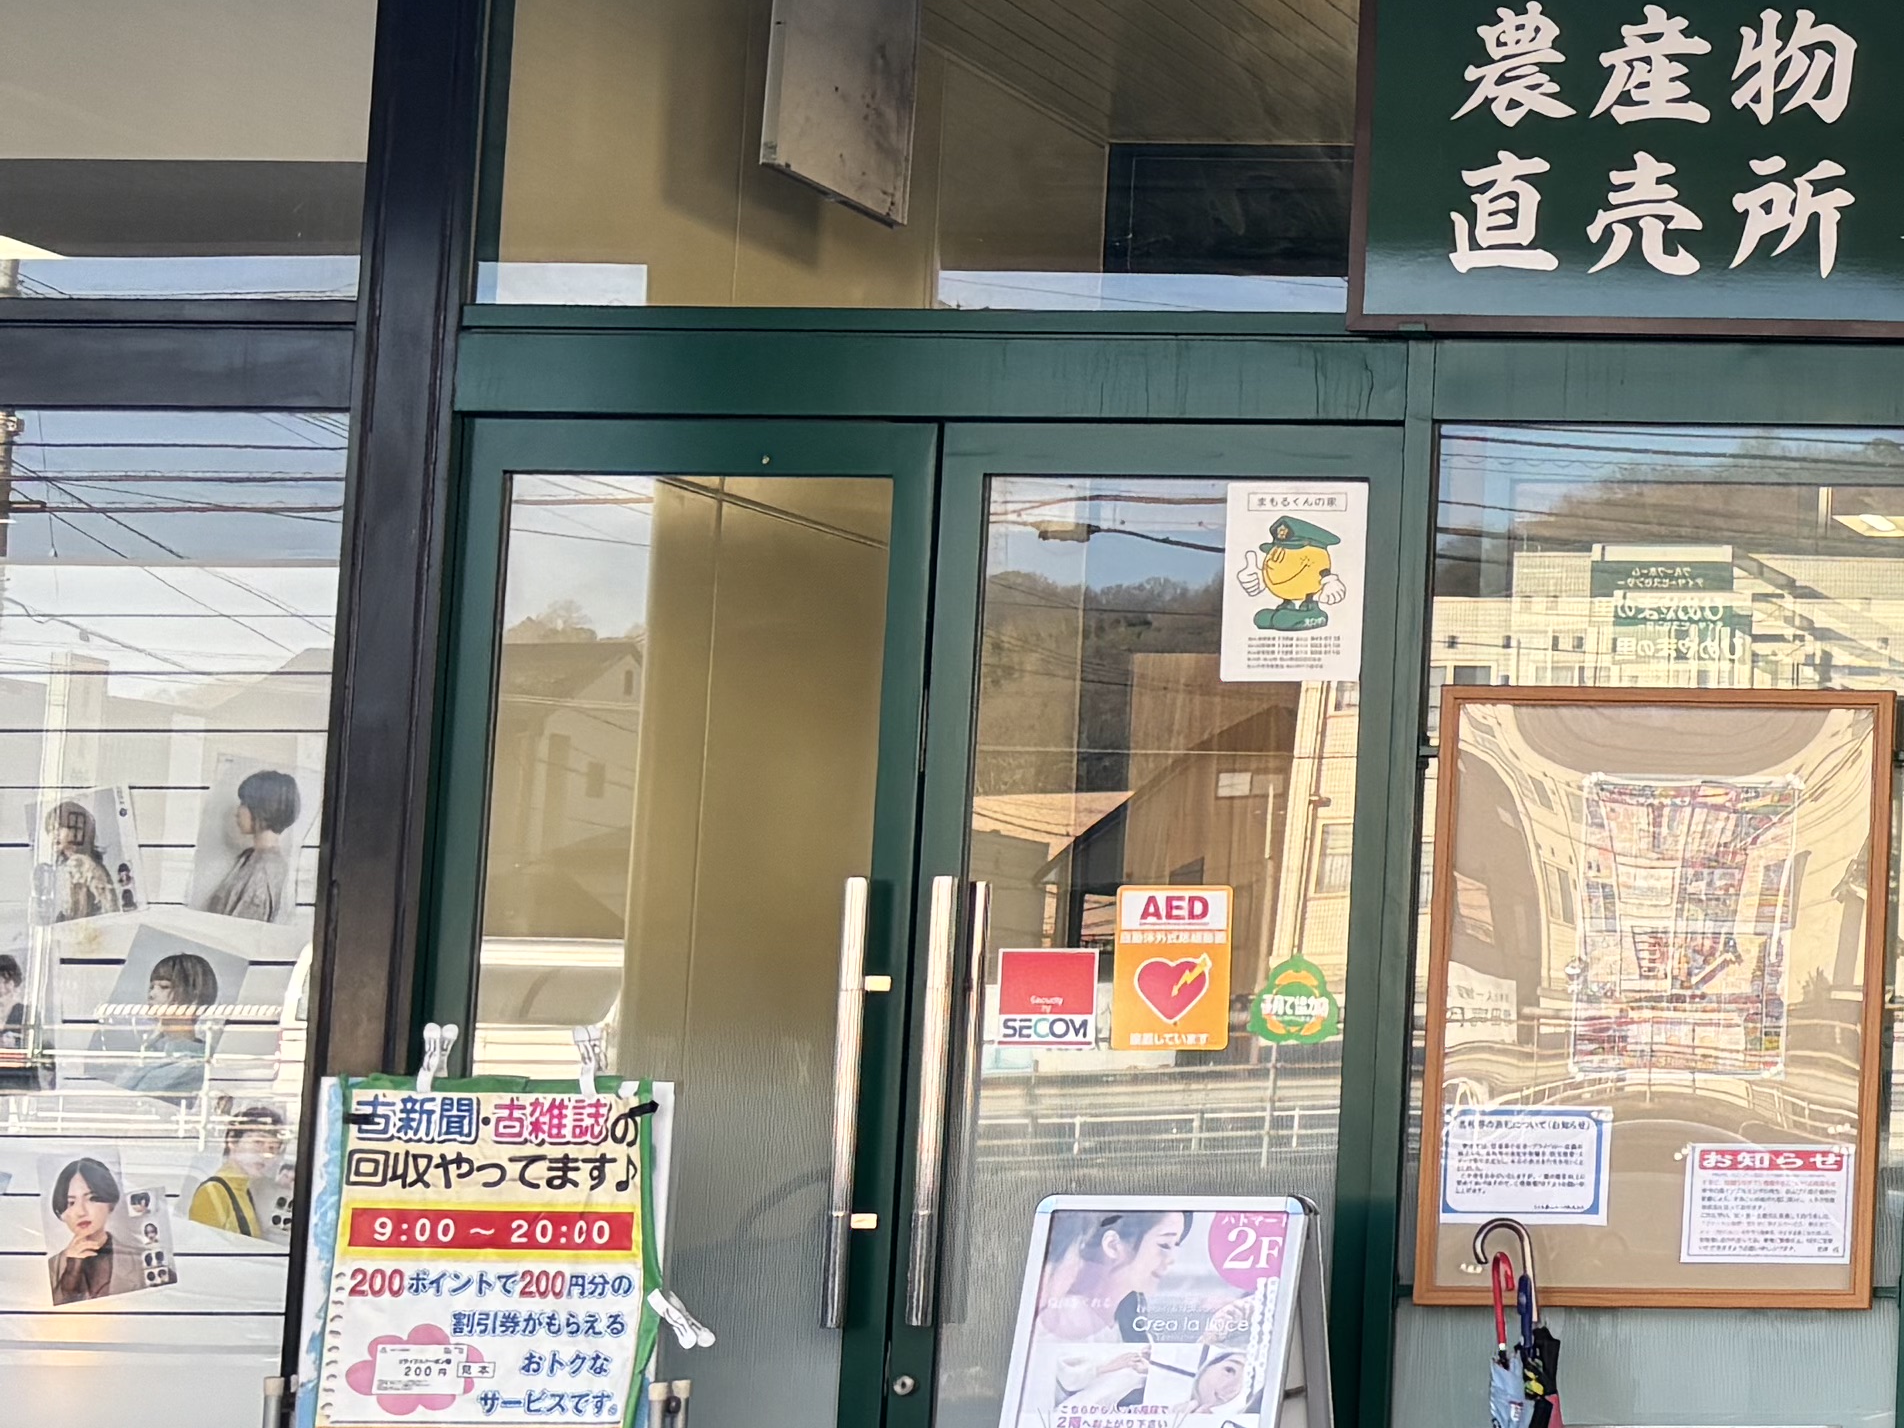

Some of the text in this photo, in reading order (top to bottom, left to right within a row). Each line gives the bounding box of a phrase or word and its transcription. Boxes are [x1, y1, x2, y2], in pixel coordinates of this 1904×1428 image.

[1449, 1, 1858, 128] 農産物
[1448, 150, 1857, 280] 直売所
[1140, 895, 1210, 921] AED
[1002, 1017, 1088, 1040] SECOM
[354, 1094, 640, 1148] 古新聞・古雑誌の
[1703, 1152, 1841, 1170] お知らせ
[373, 1217, 456, 1242] 9:00
[511, 1220, 610, 1244] 20:00
[1223, 1227, 1284, 1270] 2F
[348, 1268, 635, 1298] 200ポイントで200円分の
[451, 1310, 628, 1337] 割引券がもらえる
[462, 1364, 490, 1375] 見本
[520, 1350, 612, 1378] おトクな
[477, 1390, 618, 1417] サービスです。
